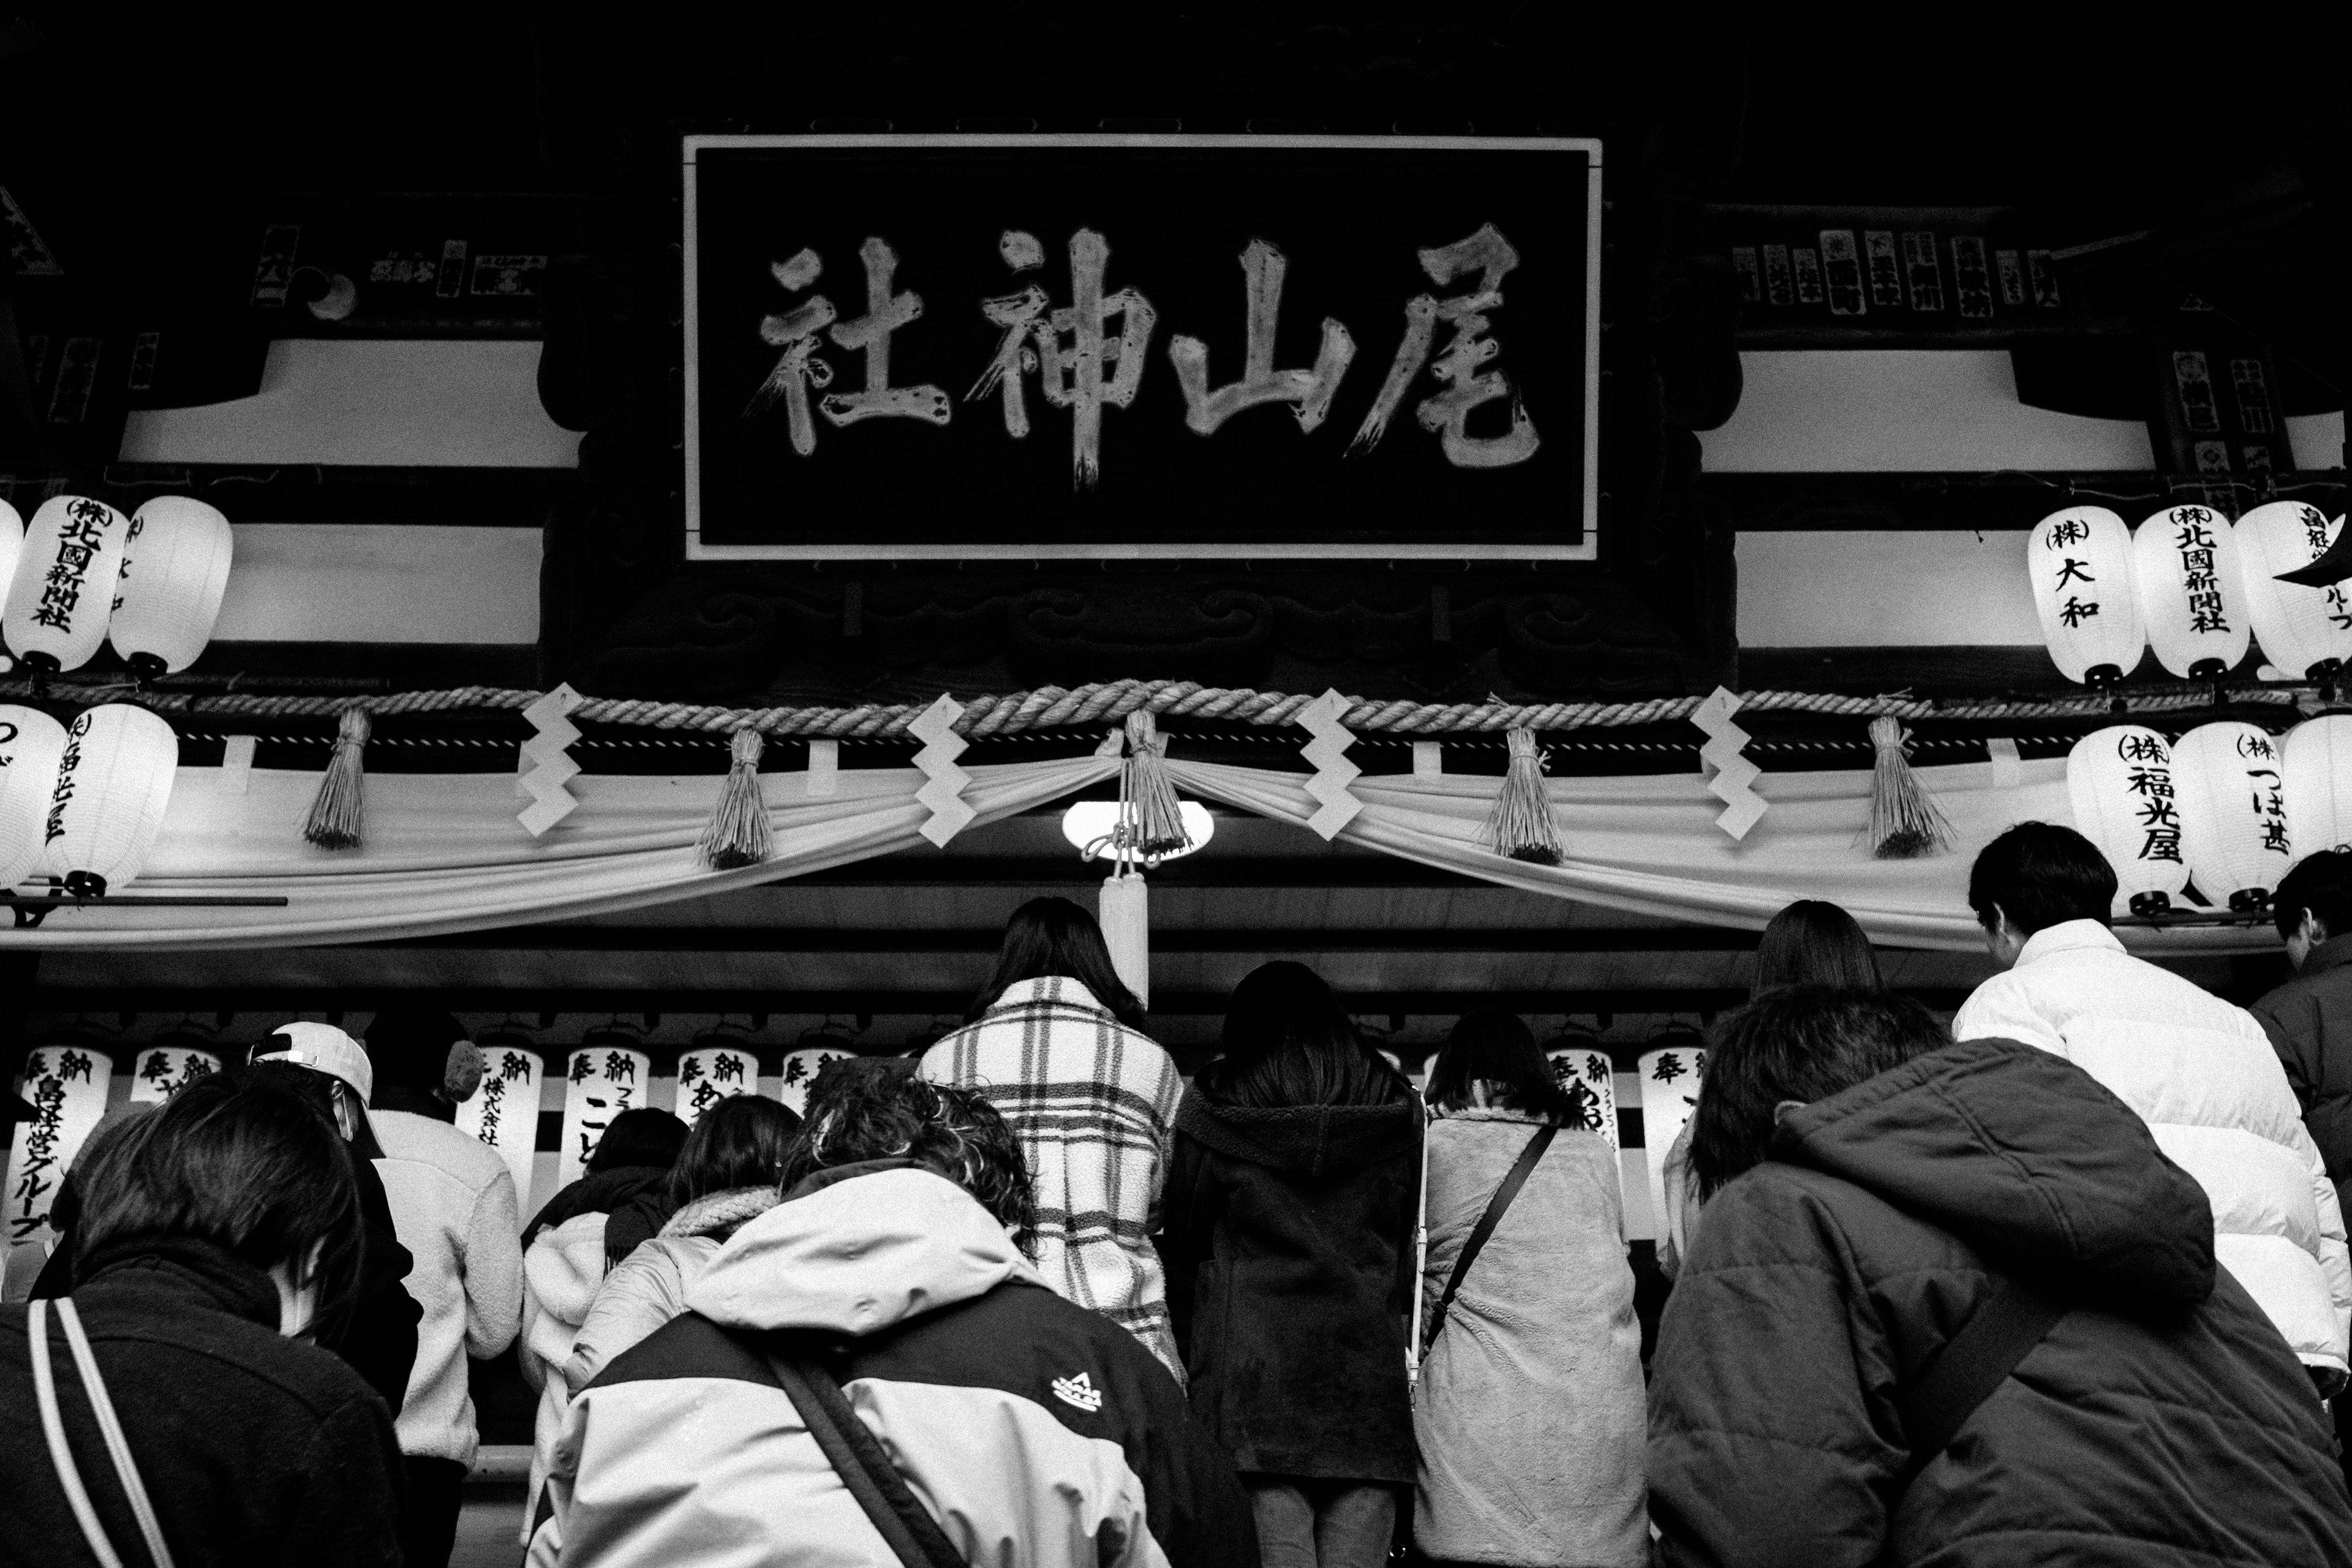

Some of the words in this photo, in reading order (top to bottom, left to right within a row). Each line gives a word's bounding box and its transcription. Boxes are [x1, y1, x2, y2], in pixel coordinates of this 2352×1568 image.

[744, 222, 1540, 490] 尾山神社
[2045, 519, 2100, 629] (株)大和
[2169, 506, 2231, 634] (株)北國新聞社
[2118, 734, 2184, 865] (株)福光屋
[483, 1050, 531, 1086] 納
[569, 1050, 635, 1086] 奉納
[679, 1052, 745, 1088] 奉納
